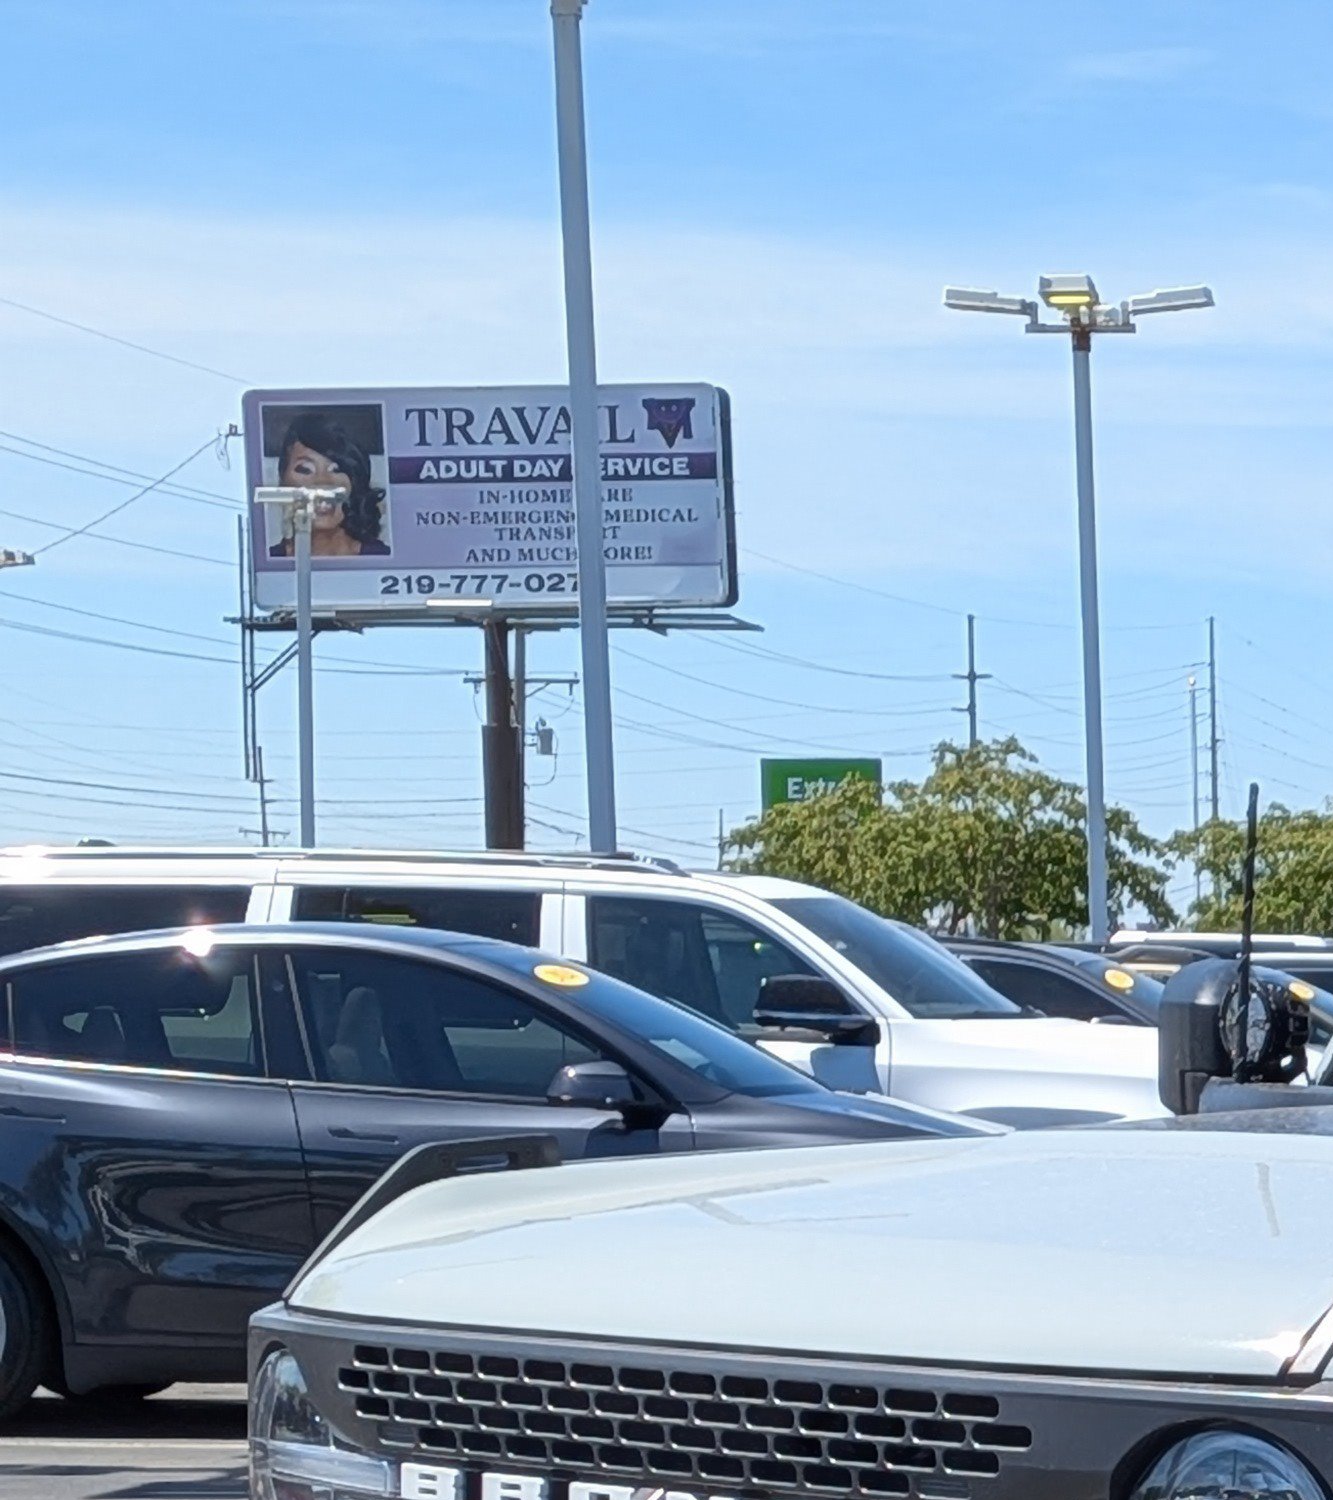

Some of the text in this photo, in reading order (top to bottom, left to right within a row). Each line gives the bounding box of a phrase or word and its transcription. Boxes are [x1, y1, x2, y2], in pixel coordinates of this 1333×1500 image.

[405, 405, 635, 446] TRAVAL
[419, 456, 690, 480] ADULT DAY RVICE
[478, 488, 572, 504] IN-HOME
[416, 507, 699, 526] NON-EMERGEN MEDICAL
[466, 548, 510, 563] AND
[604, 546, 653, 560] ORE!
[380, 572, 578, 595] 219-777-027
[787, 777, 847, 799] Extr
